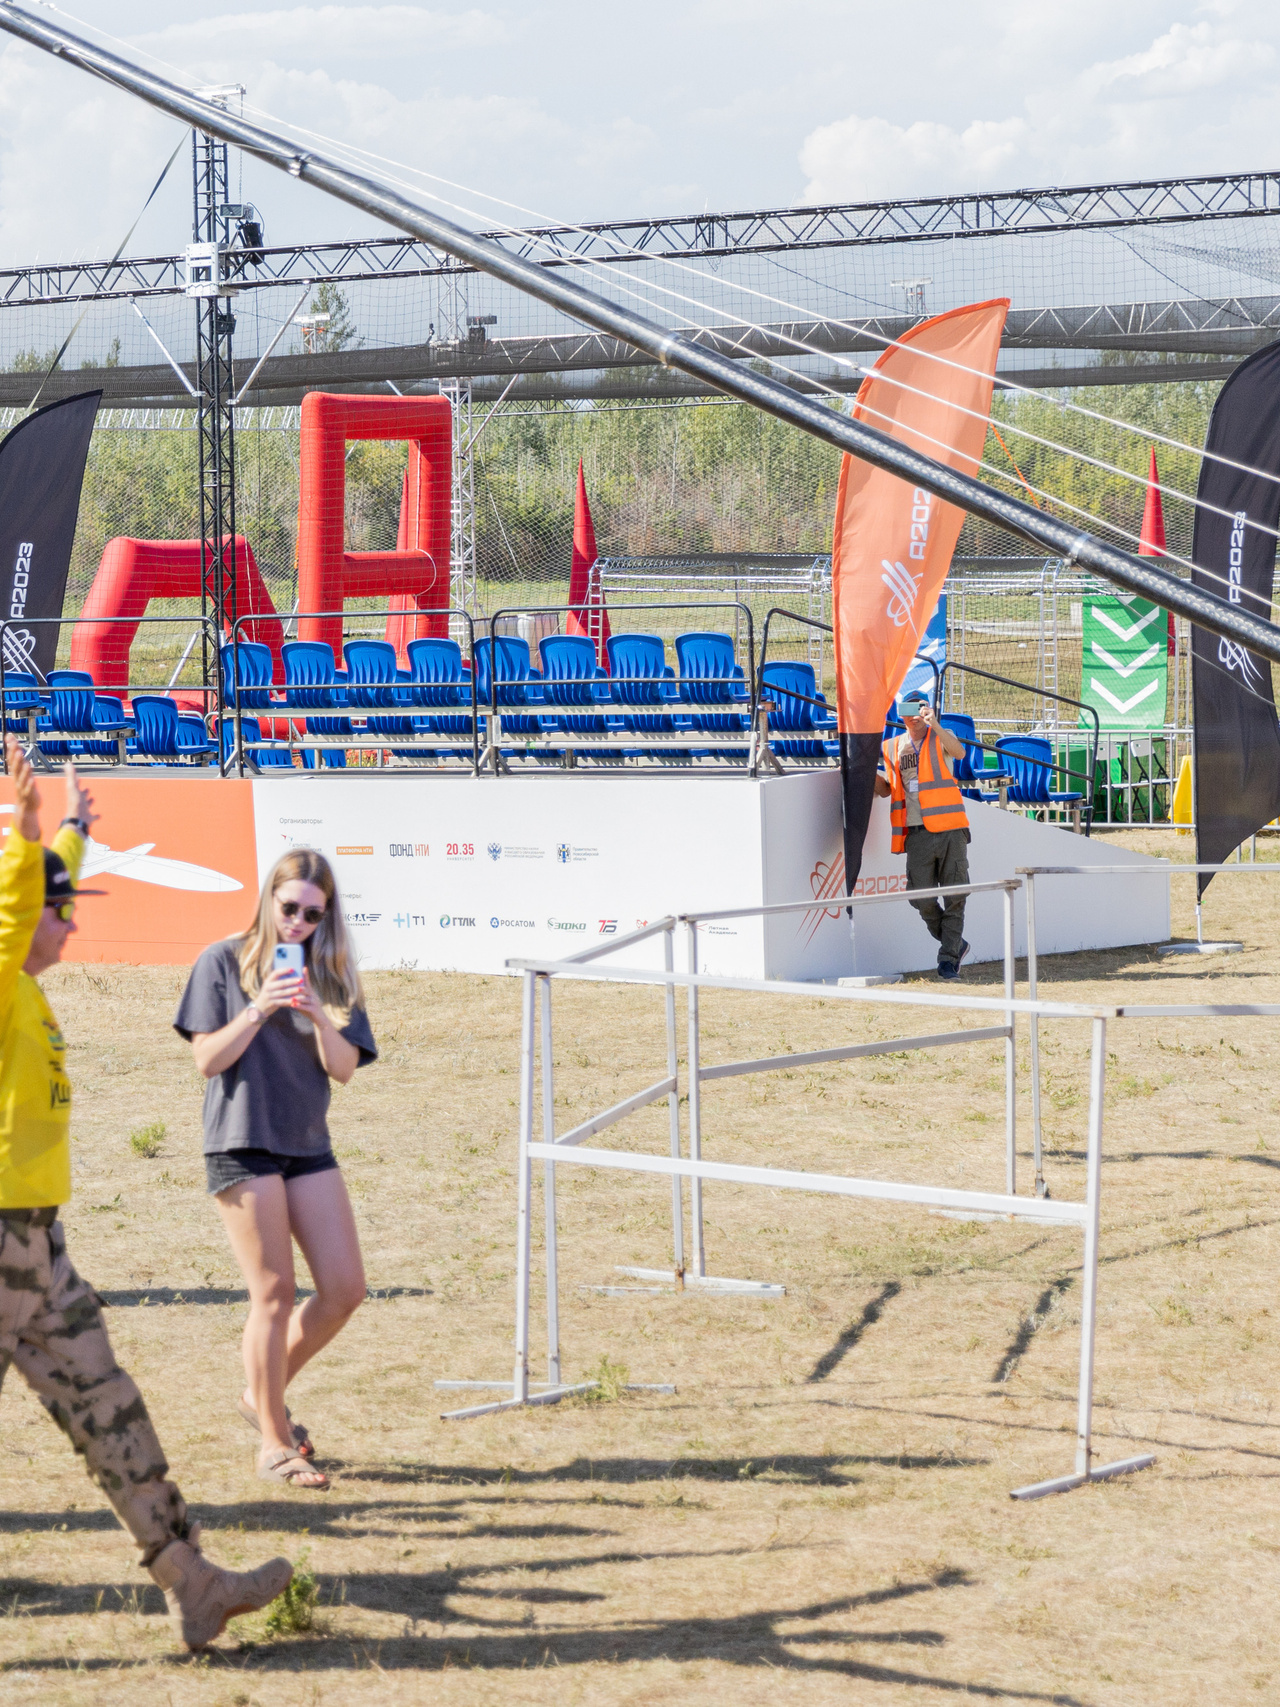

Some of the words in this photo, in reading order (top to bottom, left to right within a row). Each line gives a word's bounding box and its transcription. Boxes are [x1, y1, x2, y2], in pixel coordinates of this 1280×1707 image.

[899, 753, 917, 771] JORD
[389, 843, 414, 857] ФОНД
[415, 843, 430, 857] НТИ
[446, 843, 475, 856] 20.35
[452, 917, 476, 927] ГТЛК
[500, 919, 535, 928] РОСАТОМ
